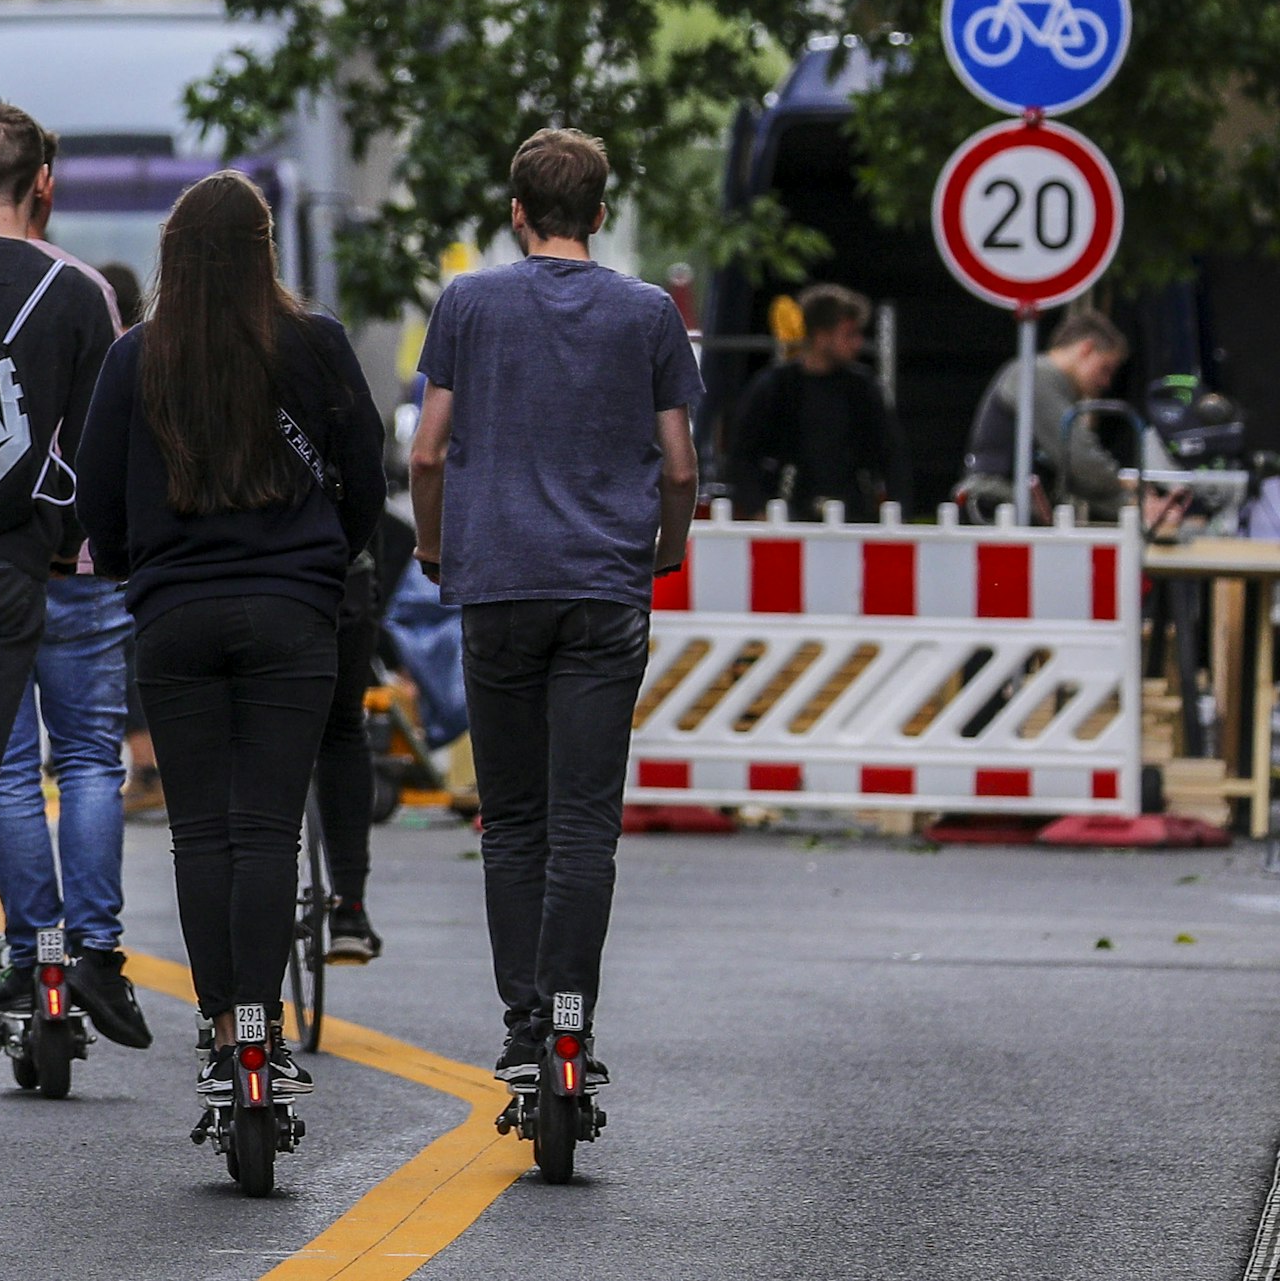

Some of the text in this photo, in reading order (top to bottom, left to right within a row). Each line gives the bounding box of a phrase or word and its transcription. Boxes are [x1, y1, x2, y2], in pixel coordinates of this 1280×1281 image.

[982, 180, 1074, 250] 20
[292, 433, 314, 461] FILA
[556, 995, 581, 1010] 305
[239, 1007, 263, 1022] 291
[557, 1011, 580, 1027] IAD
[240, 1024, 263, 1039] IBA
